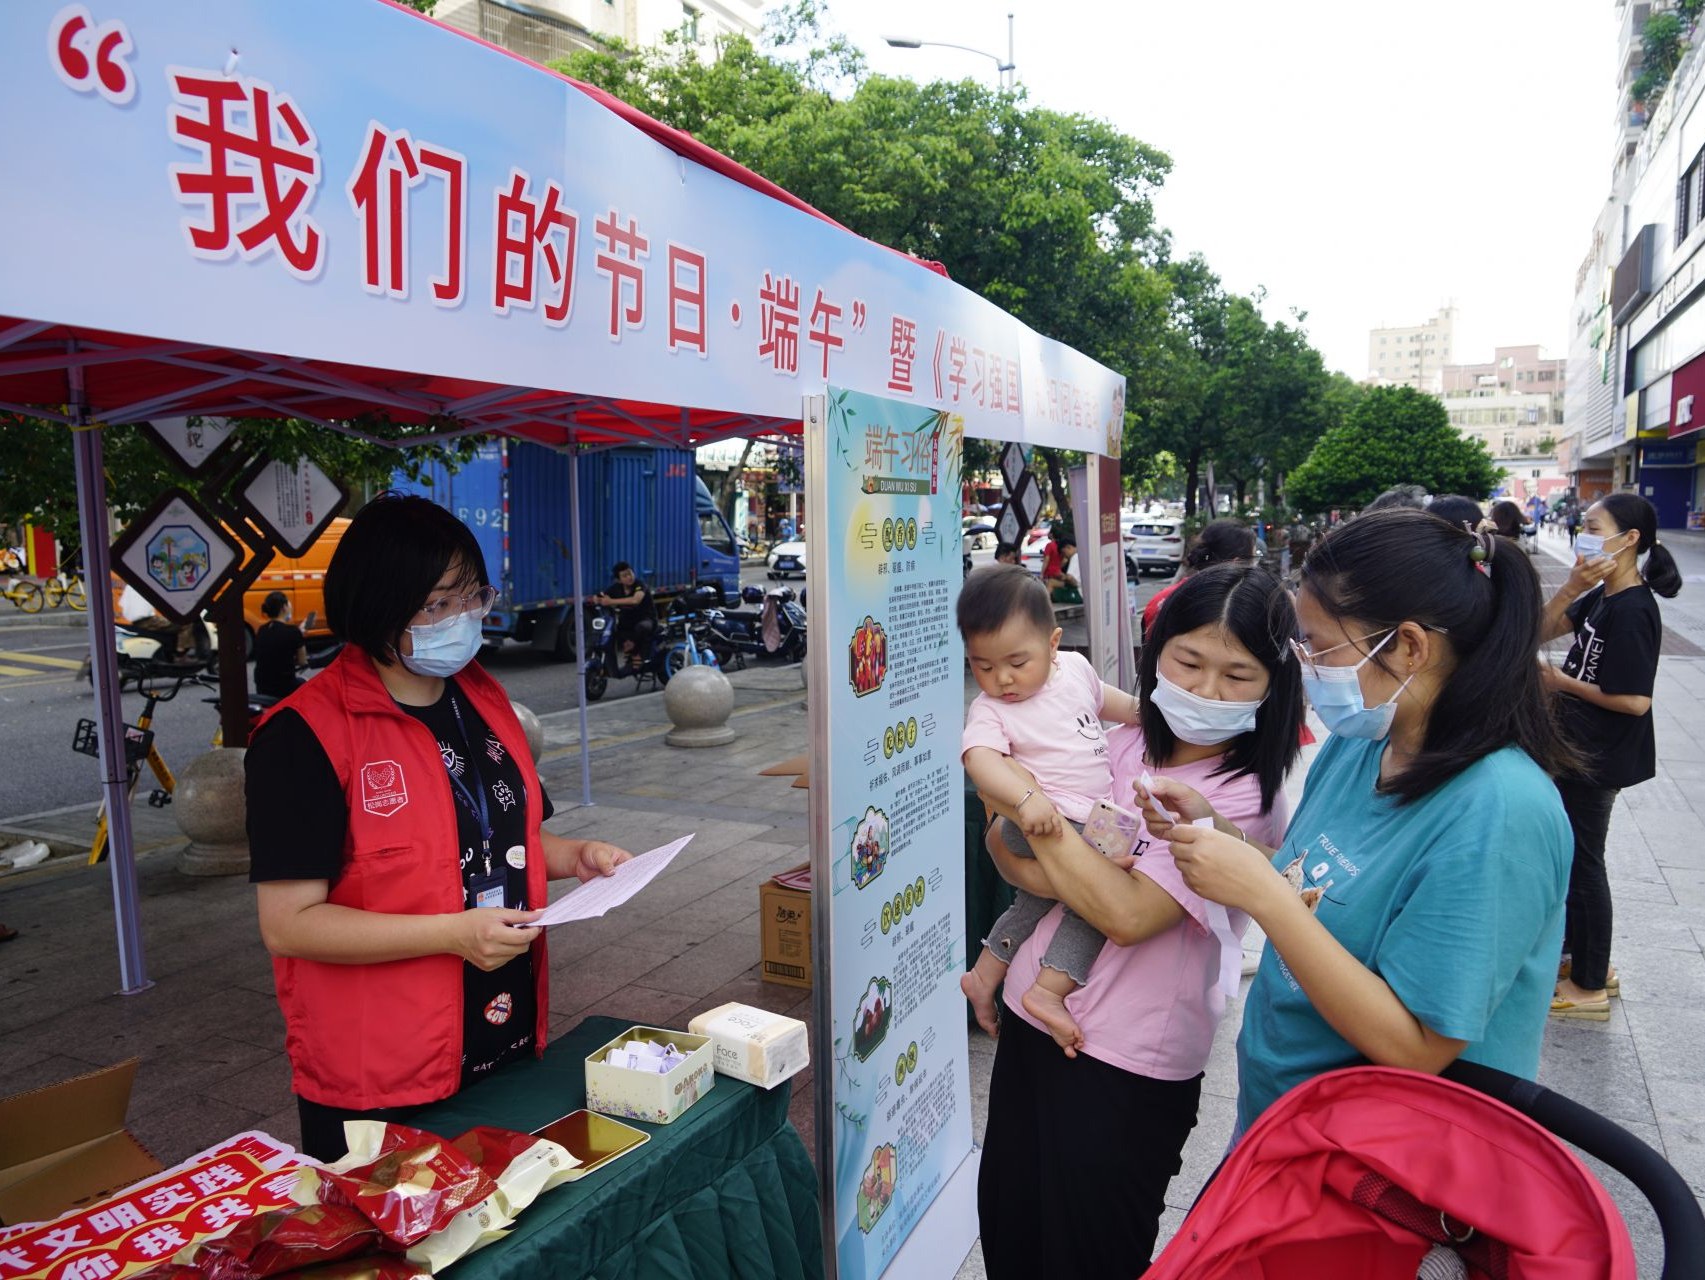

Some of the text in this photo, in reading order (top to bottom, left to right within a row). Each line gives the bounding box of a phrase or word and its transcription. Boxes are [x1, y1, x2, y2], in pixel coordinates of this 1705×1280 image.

[864, 423, 931, 474] 端午习俗
[880, 480, 917, 493] DUAN WU XI SU
[1317, 833, 1339, 856] TRUE
[716, 1044, 738, 1060] Face
